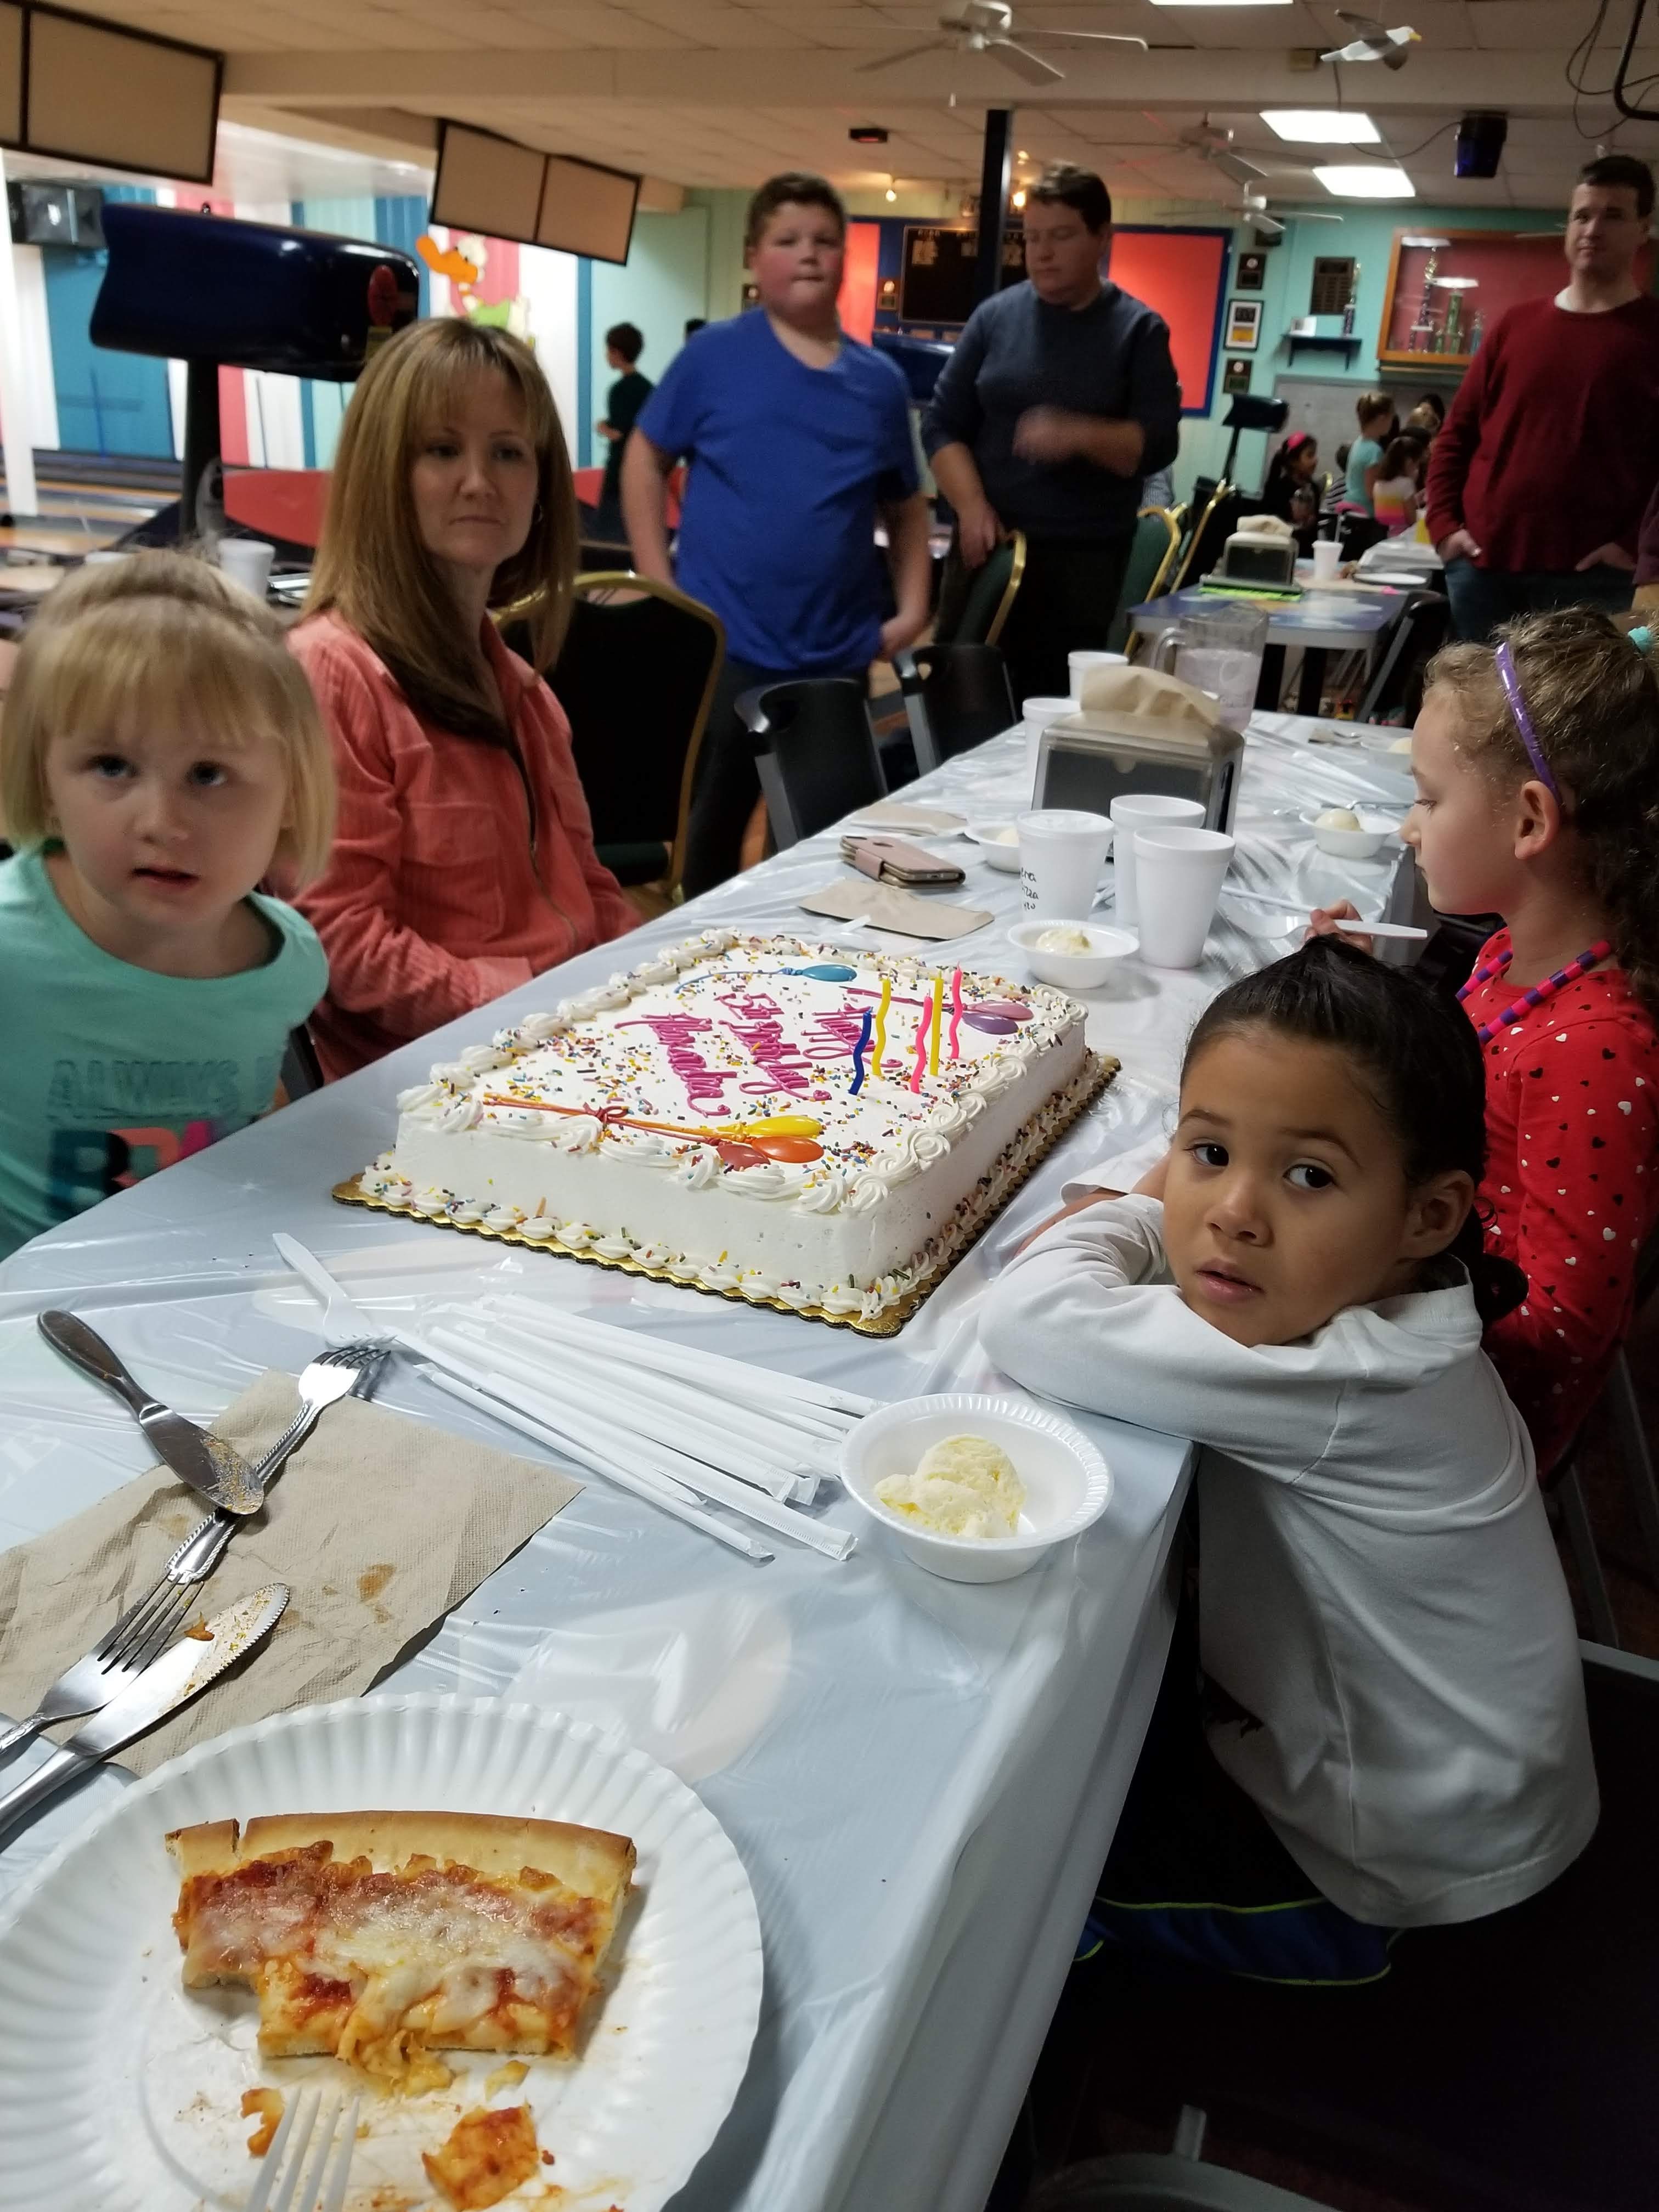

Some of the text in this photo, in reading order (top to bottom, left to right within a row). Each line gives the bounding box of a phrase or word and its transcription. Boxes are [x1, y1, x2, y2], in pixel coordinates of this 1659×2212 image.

[714, 992, 833, 1102] 5th Birthday
[800, 1003, 904, 1068] Happy
